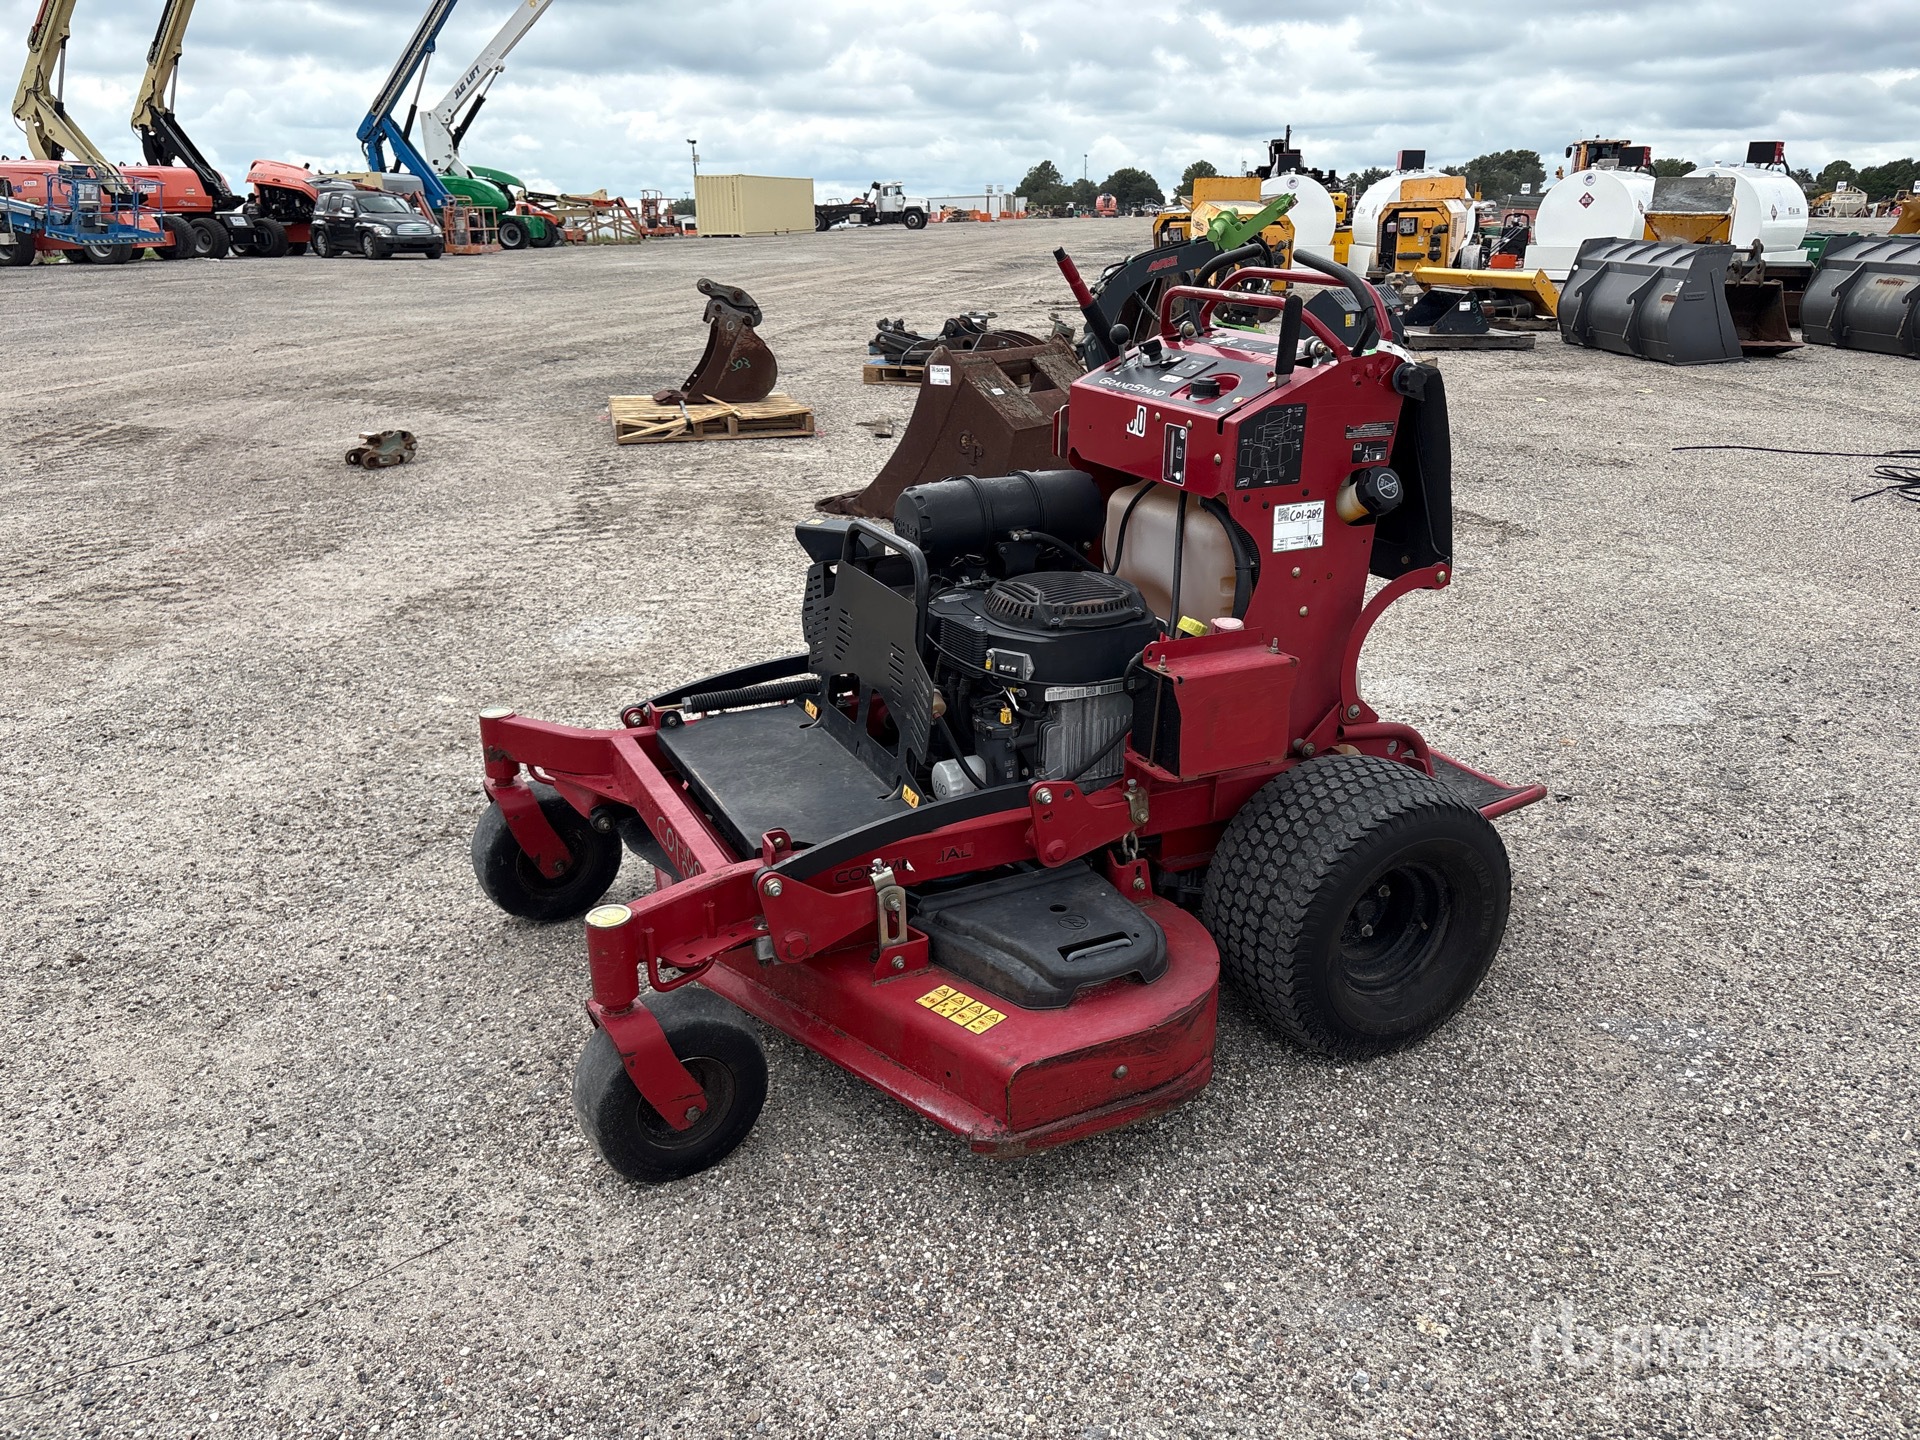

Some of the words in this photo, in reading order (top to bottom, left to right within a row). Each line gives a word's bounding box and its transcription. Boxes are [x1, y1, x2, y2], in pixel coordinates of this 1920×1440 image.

[454, 82, 467, 100] JLG
[465, 65, 481, 86] LIFT
[1429, 182, 1436, 192] 7
[1290, 507, 1323, 522] C01-289
